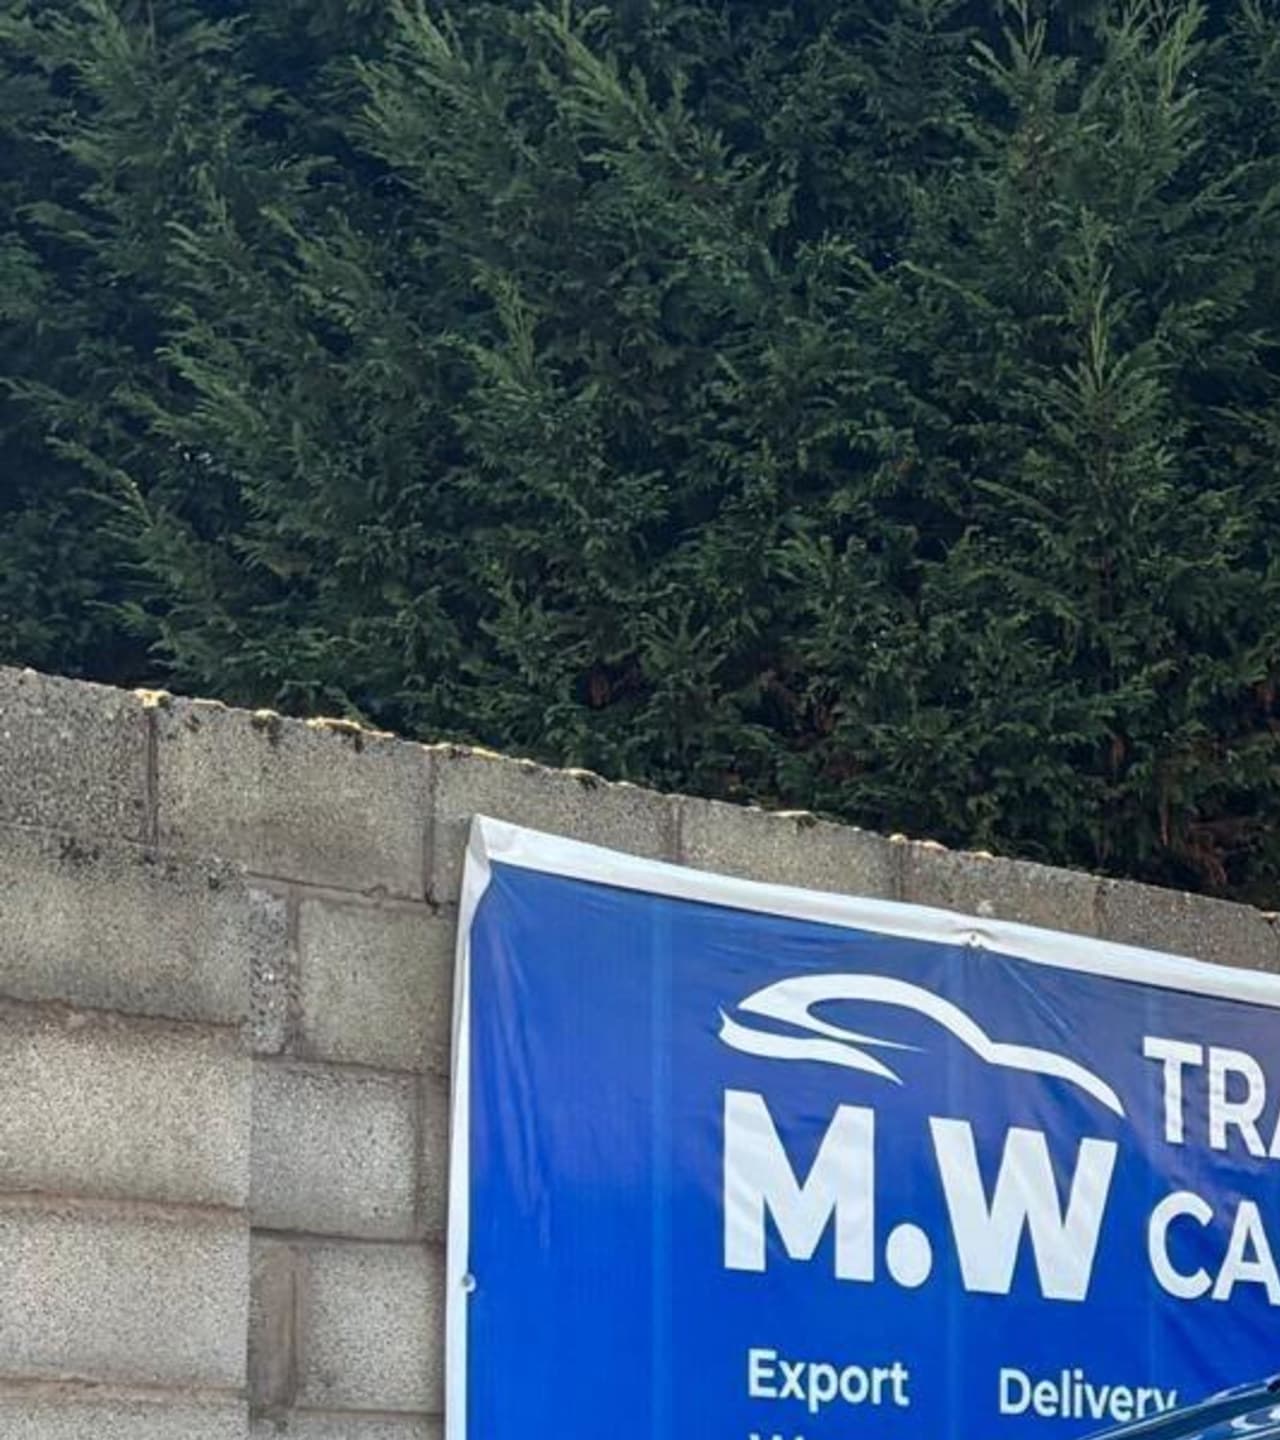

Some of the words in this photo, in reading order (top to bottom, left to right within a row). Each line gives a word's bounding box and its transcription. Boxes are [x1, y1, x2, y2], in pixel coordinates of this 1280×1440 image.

[723, 1087, 1118, 1302] M.W
[748, 1348, 909, 1414] Export
[999, 1367, 1177, 1423] Delivery
